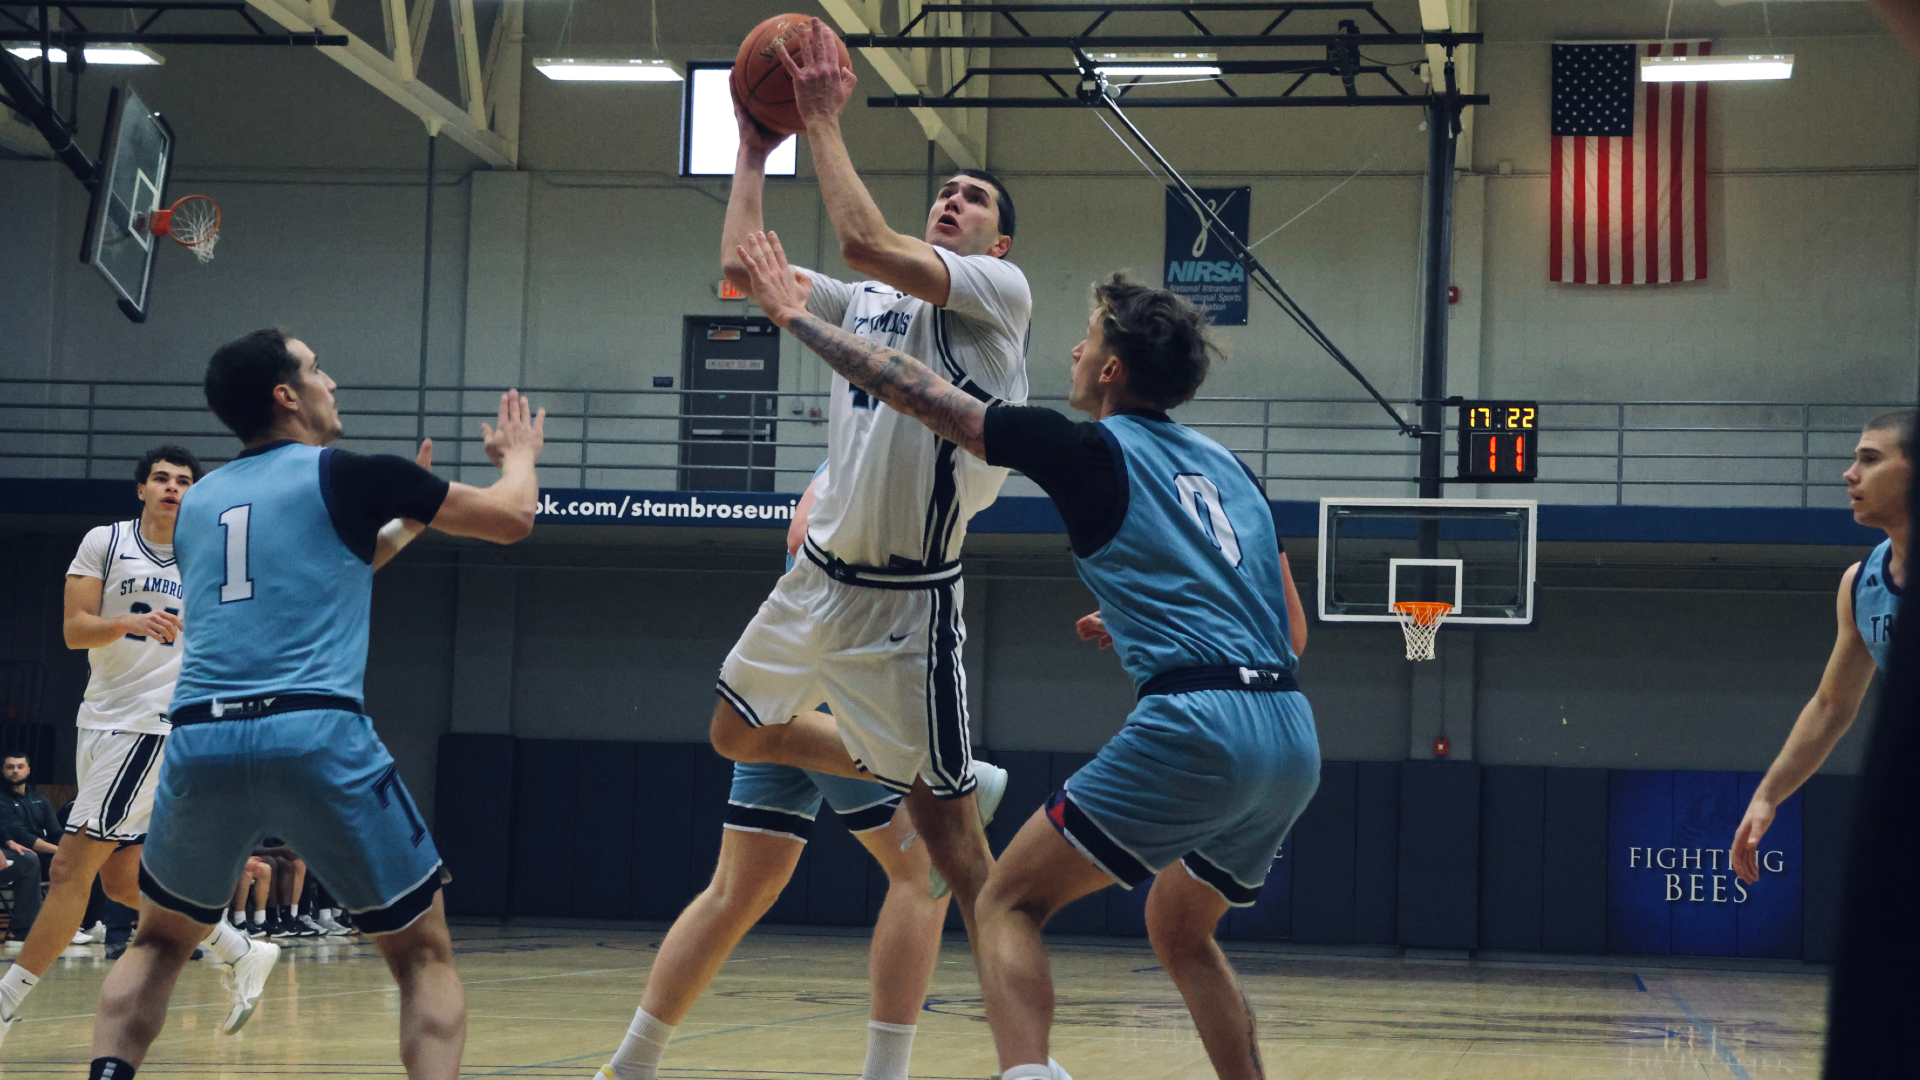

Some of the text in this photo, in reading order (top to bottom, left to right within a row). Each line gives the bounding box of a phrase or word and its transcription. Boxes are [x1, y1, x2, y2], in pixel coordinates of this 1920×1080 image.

[1167, 260, 1245, 282] NIRSA
[1169, 284, 1240, 293] National Intramural
[1218, 293, 1241, 303] Sports
[1489, 435, 1524, 472] 11
[1173, 471, 1243, 570] 0
[218, 503, 254, 605] 1
[120, 576, 183, 600] ST. AMBRO
[1664, 873, 1748, 903] BEES
